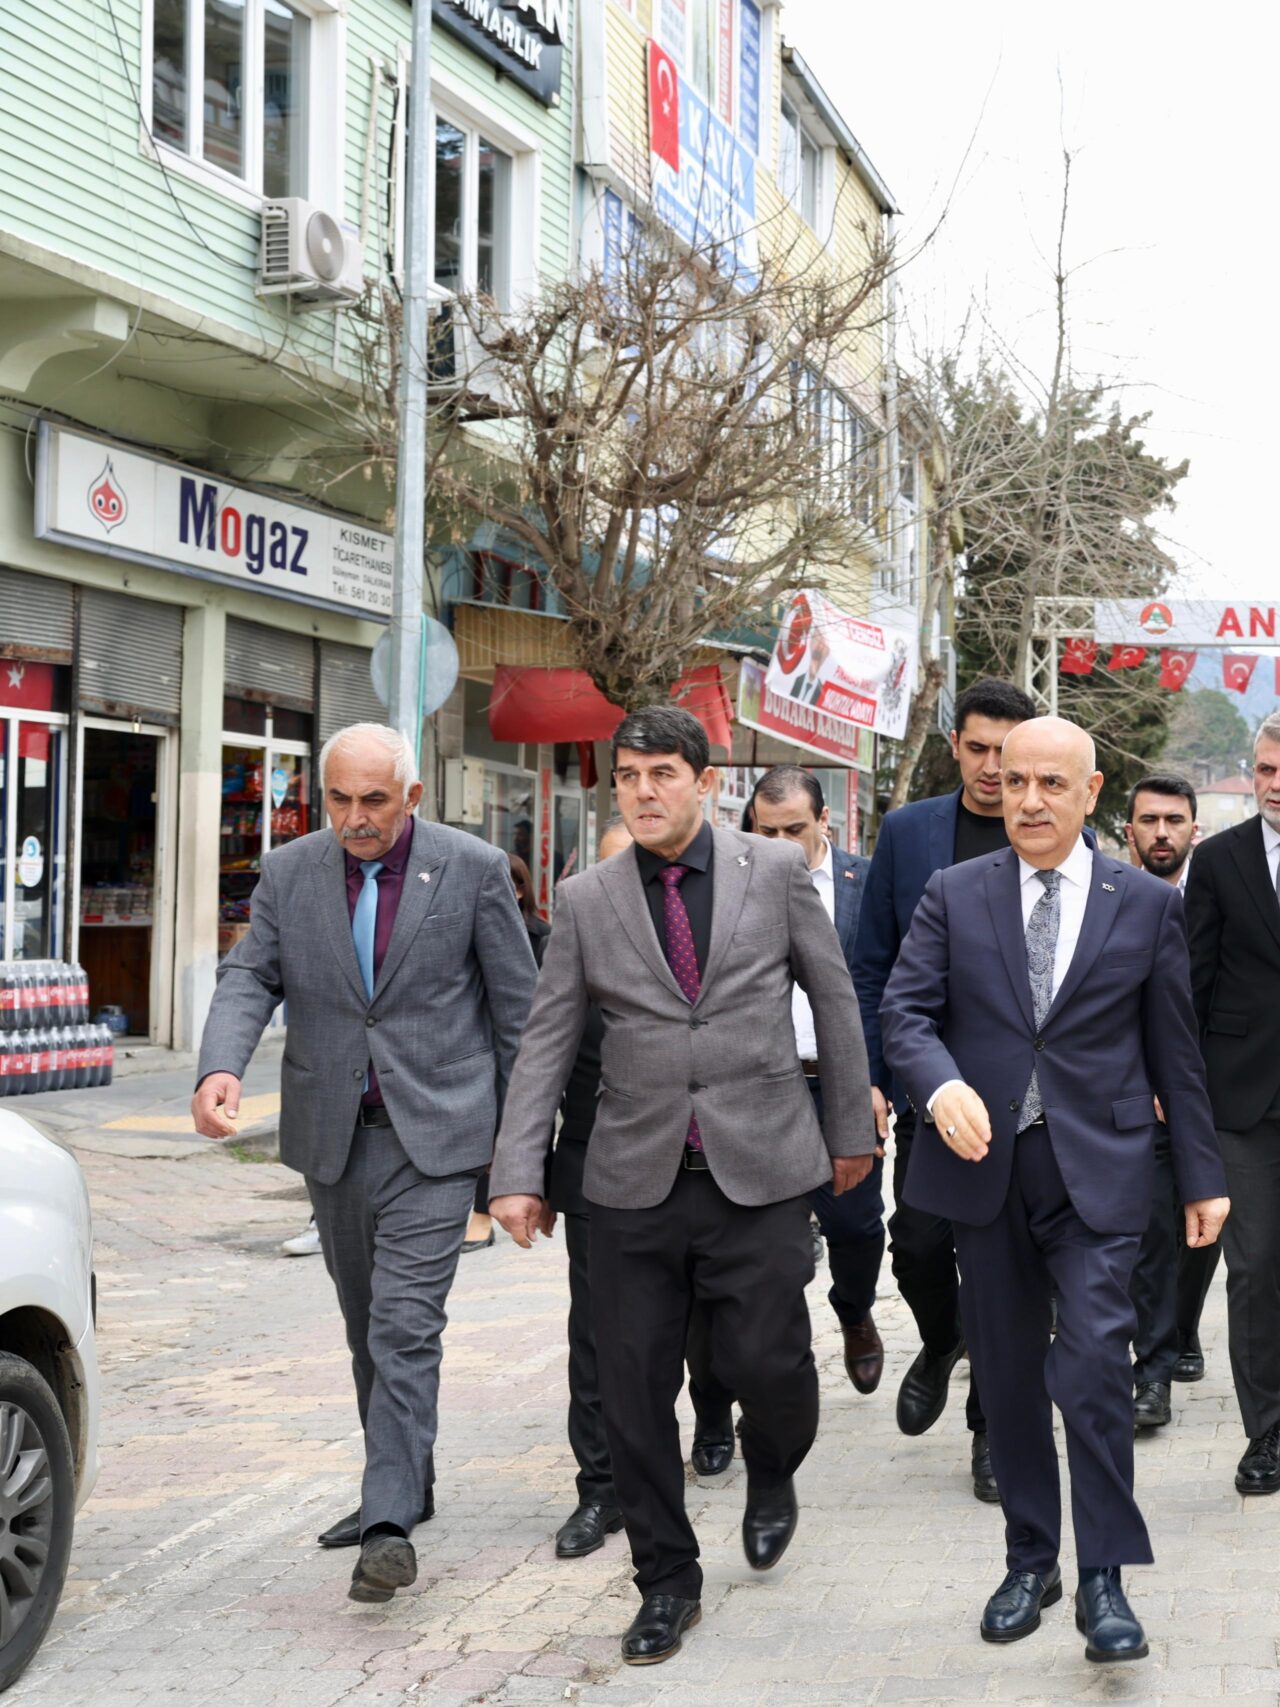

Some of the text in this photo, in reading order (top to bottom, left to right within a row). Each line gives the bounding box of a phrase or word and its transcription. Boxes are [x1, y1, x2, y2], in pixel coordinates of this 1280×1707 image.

[453, 0, 543, 70] MARLIK
[687, 100, 746, 201] KAYA
[179, 476, 309, 576] Mogaz
[340, 527, 387, 553] KISMET
